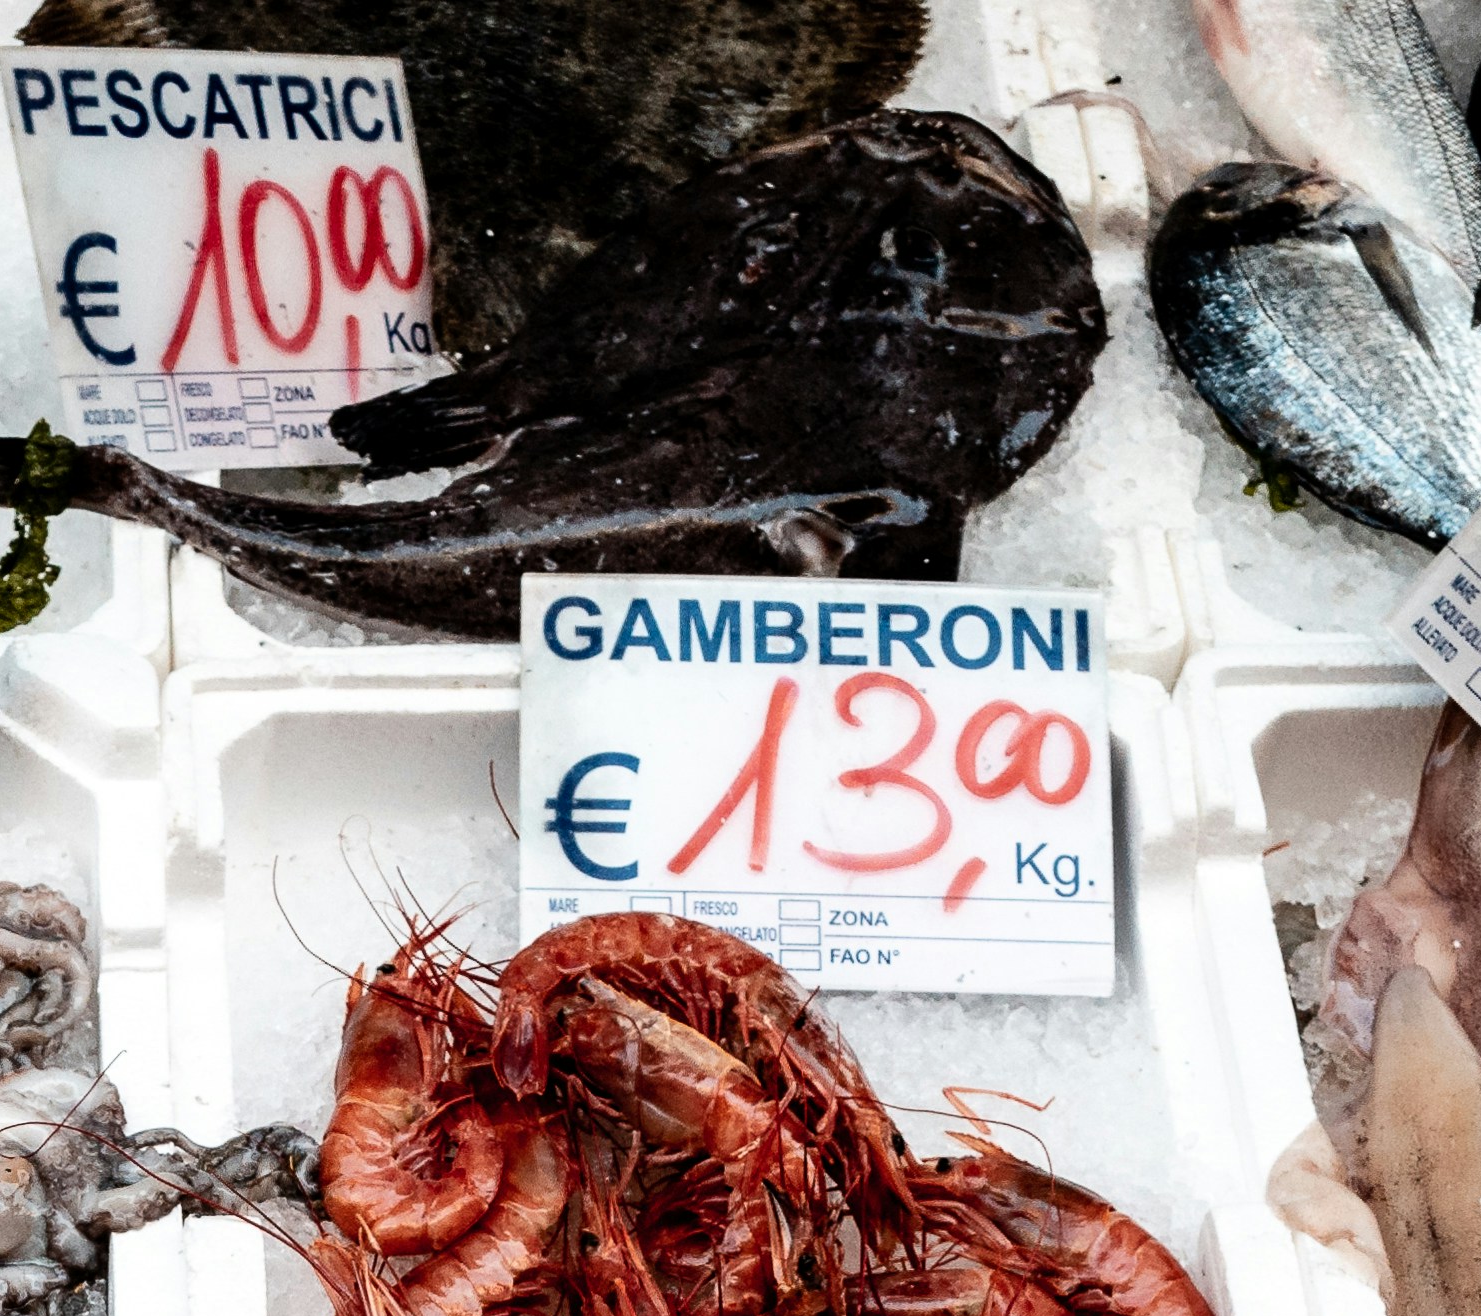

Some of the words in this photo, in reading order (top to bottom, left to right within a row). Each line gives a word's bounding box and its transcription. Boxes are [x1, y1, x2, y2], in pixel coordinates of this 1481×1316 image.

[13, 67, 403, 142] PESCATRICI
[56, 231, 137, 366] €
[274, 386, 315, 401] ZONA
[280, 424, 308, 440] FAO
[1450, 573, 1481, 604] MARE
[1431, 595, 1467, 633] ACQUE
[543, 596, 1090, 672] GAMBERONI
[1412, 616, 1458, 663] ALLEVATO
[544, 751, 639, 881] €
[1015, 842, 1096, 897] Kg.
[549, 898, 579, 913] MARE
[693, 901, 737, 915] FRESCO
[829, 910, 888, 926] ZONA
[830, 949, 870, 964] FAO
[878, 949, 900, 965] N°
